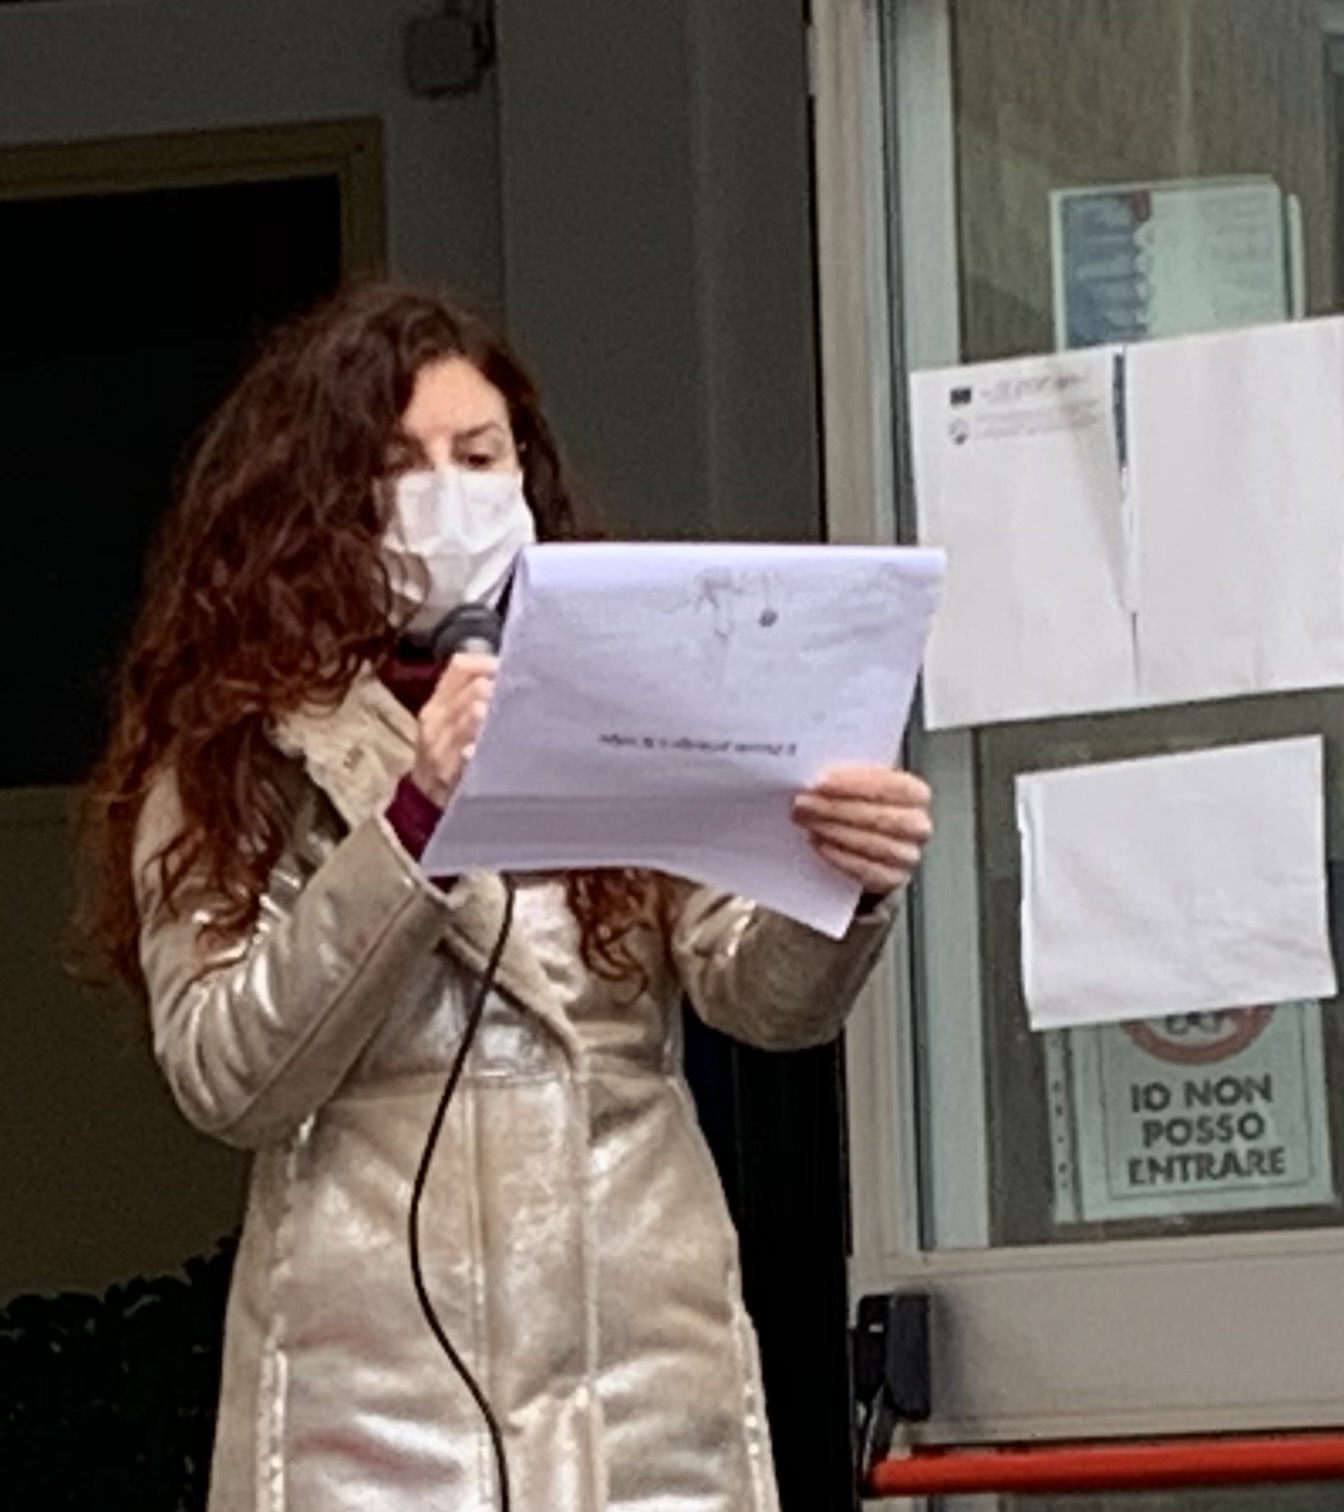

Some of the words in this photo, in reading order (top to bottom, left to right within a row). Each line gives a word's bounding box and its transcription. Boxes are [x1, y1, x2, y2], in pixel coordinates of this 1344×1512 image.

[1131, 1080, 1172, 1113] IO
[1183, 1073, 1273, 1108] NON
[1142, 1111, 1267, 1149] POSSO
[1127, 1147, 1286, 1187] ENTRARE
